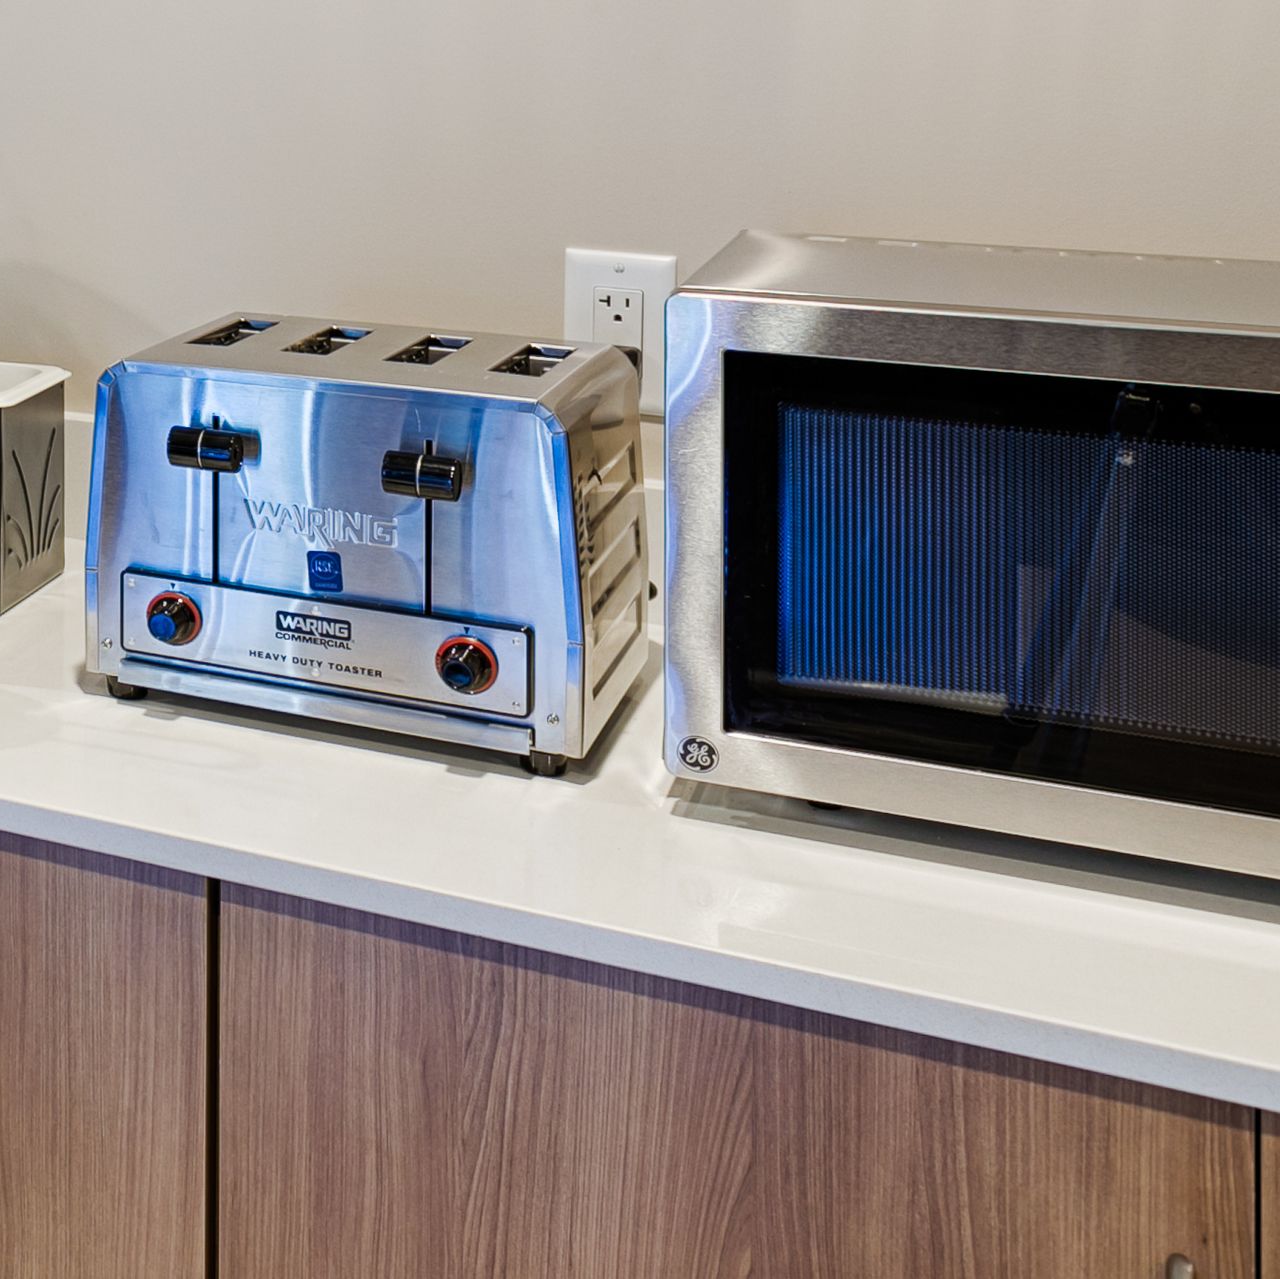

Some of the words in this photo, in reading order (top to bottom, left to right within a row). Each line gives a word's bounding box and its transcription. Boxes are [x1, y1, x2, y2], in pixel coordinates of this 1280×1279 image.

[243, 497, 399, 549] WARING
[279, 614, 349, 638] WARING
[275, 631, 352, 650] COMMERCIAL
[249, 649, 287, 662] HEAVY
[292, 656, 323, 668] DUTY
[328, 662, 382, 678] TOASTER
